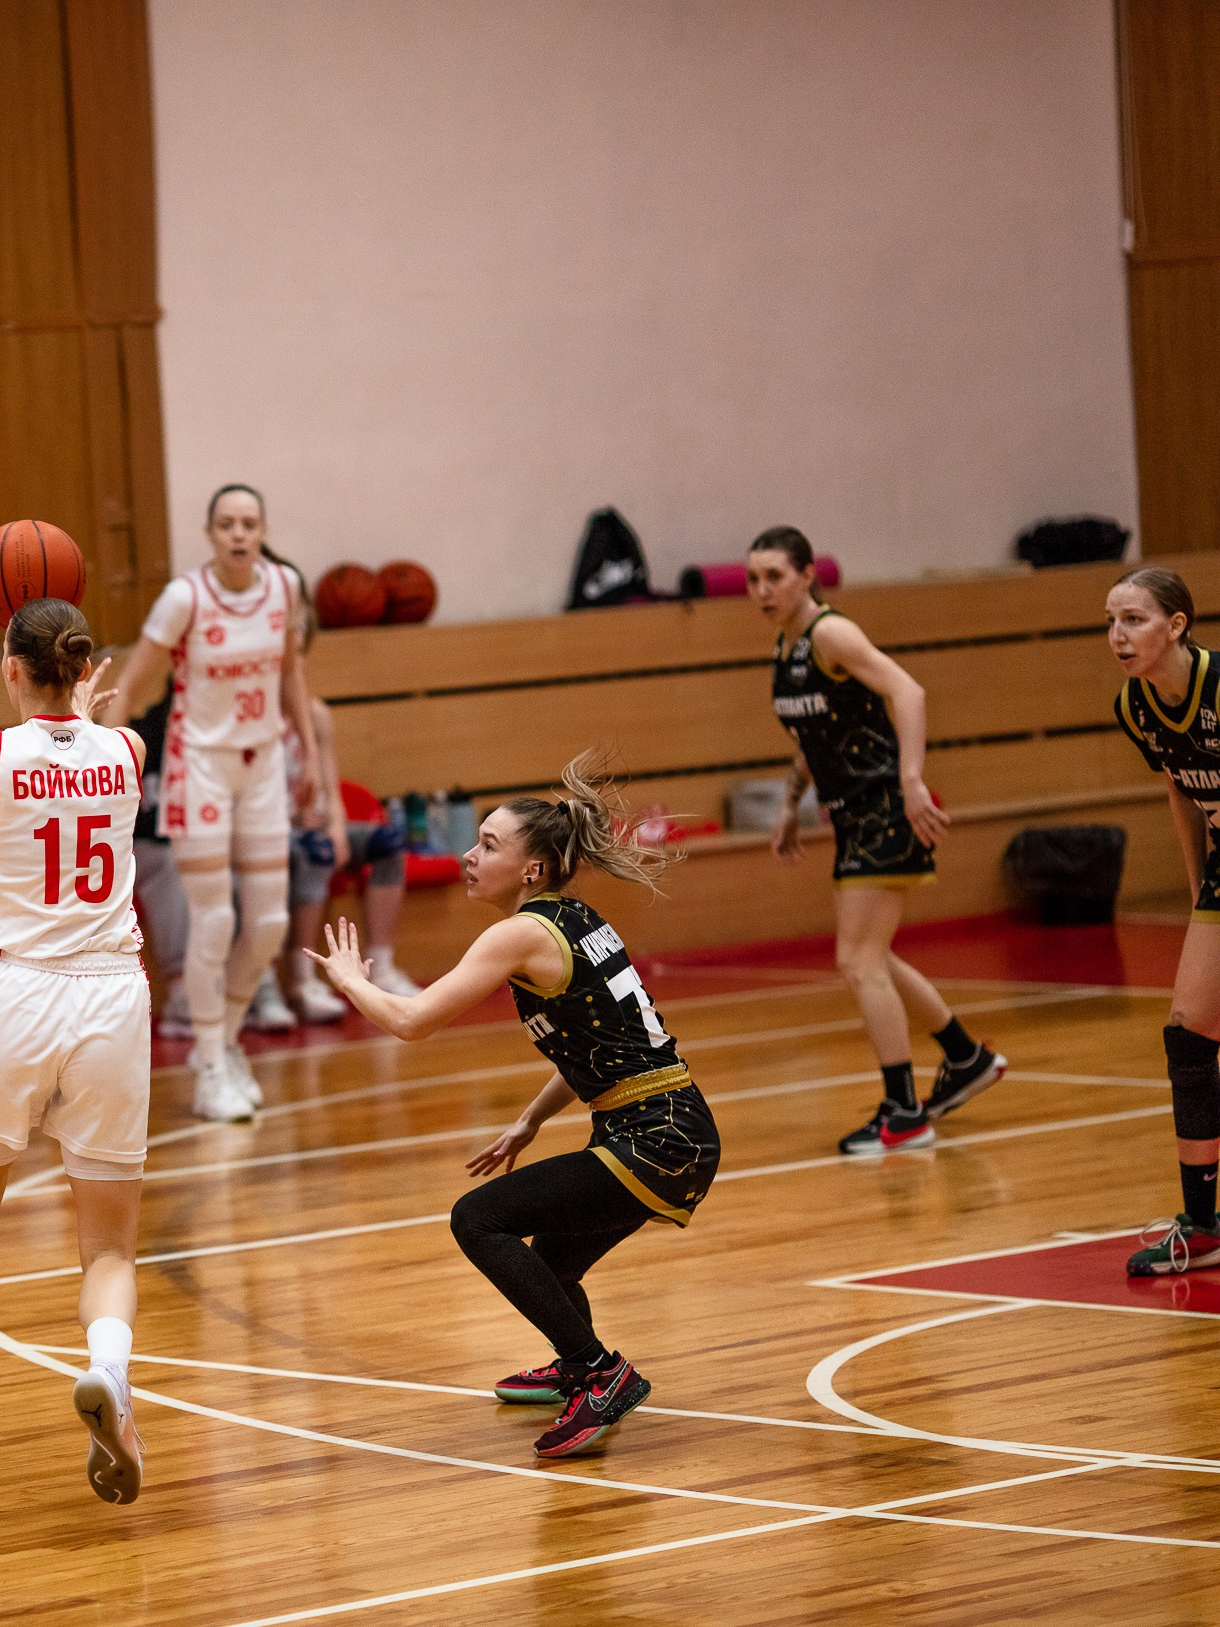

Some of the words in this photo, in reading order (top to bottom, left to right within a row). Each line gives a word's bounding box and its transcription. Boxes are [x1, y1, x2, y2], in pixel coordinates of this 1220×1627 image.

[235, 688, 266, 723] 30
[53, 736, 72, 744] РФБ
[12, 763, 126, 800] БОЙКОВА
[33, 814, 115, 905] 15
